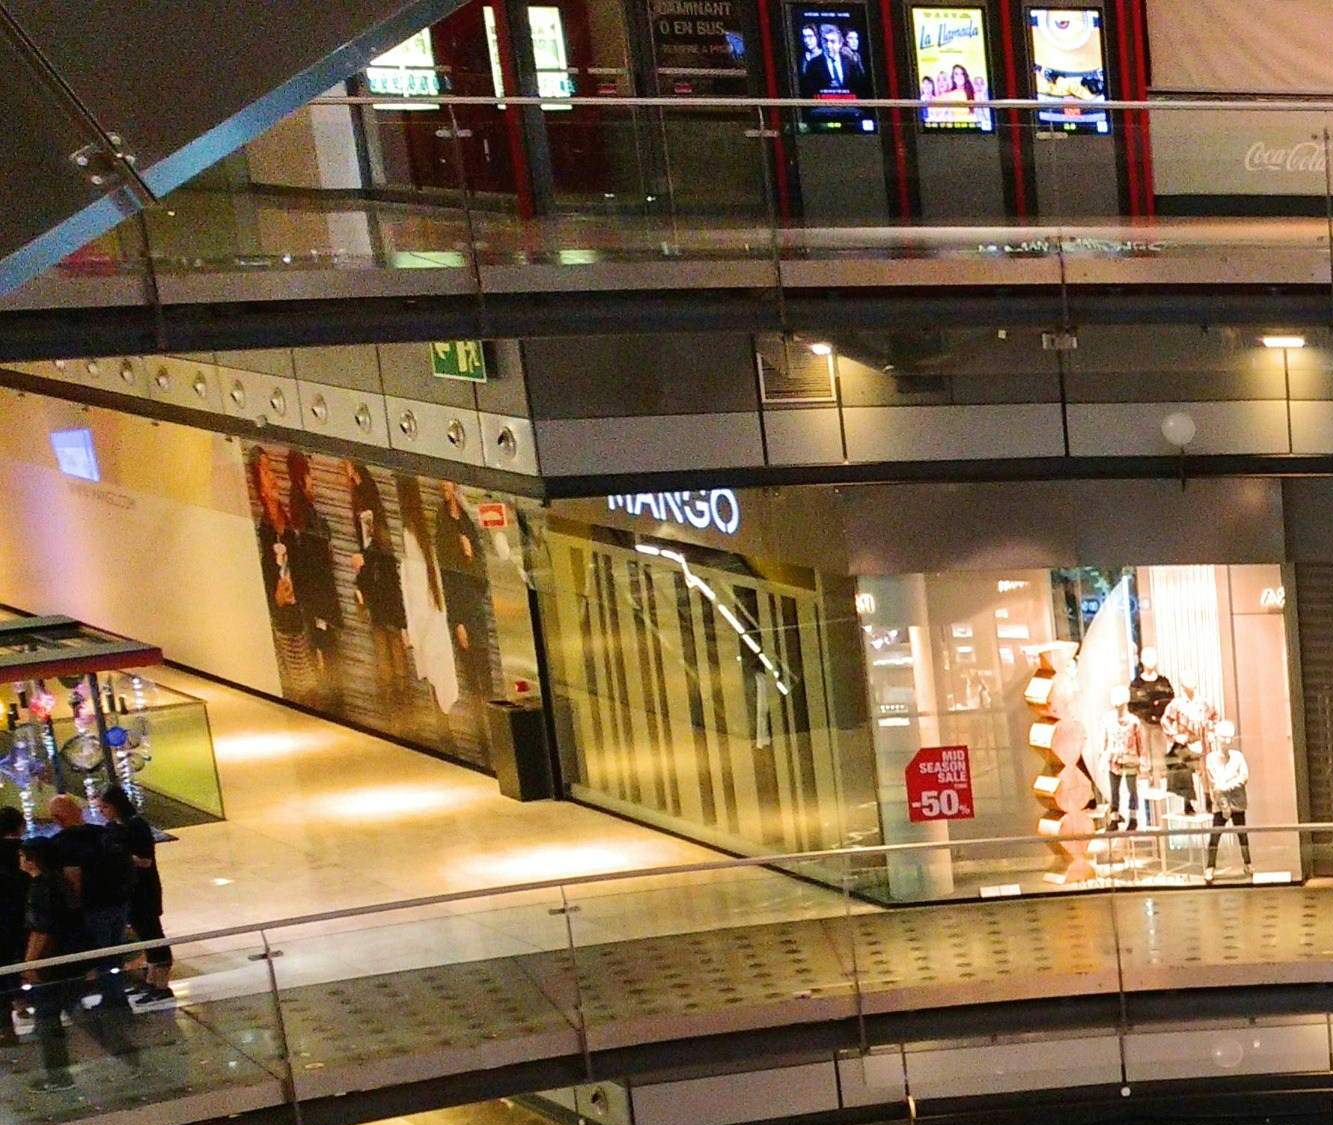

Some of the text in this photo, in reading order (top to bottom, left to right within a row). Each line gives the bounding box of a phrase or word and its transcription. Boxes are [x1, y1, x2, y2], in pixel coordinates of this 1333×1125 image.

[942, 750, 966, 761] MID
[918, 760, 967, 775] SEASON
[937, 770, 967, 783] SALE
[911, 789, 970, 817] -50%
